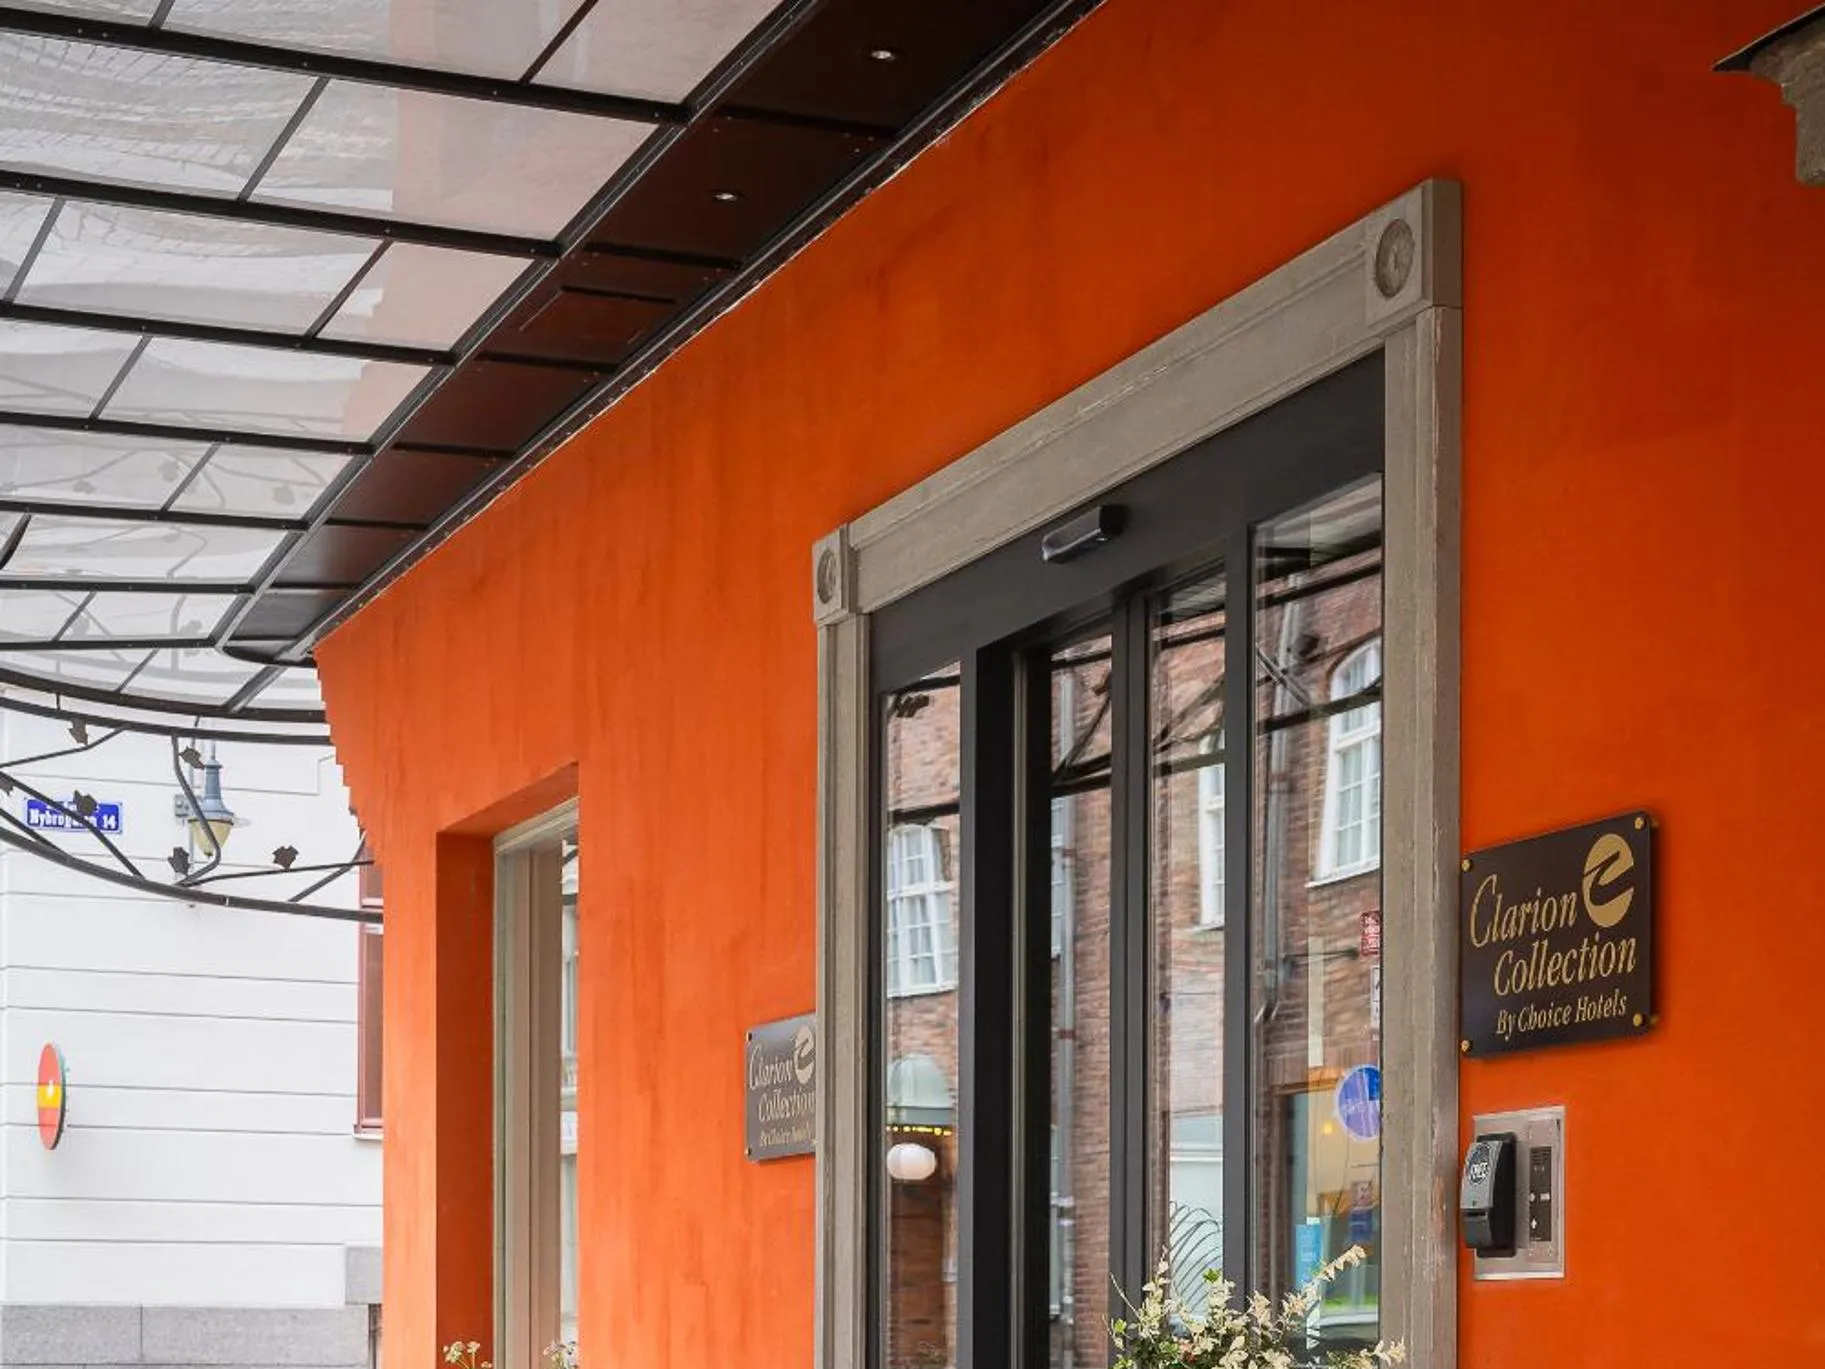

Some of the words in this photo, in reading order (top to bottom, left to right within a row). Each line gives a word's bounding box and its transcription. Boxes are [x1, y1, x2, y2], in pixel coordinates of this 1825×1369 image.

[103, 815, 117, 829] 14
[1470, 873, 1577, 948] Clarion
[1493, 932, 1637, 996] Collection
[1496, 1009, 1515, 1042] By
[1518, 1002, 1571, 1033] Choice
[1575, 988, 1627, 1023] Hotels
[749, 1043, 793, 1091] Clarion
[758, 1088, 816, 1122] Collection
